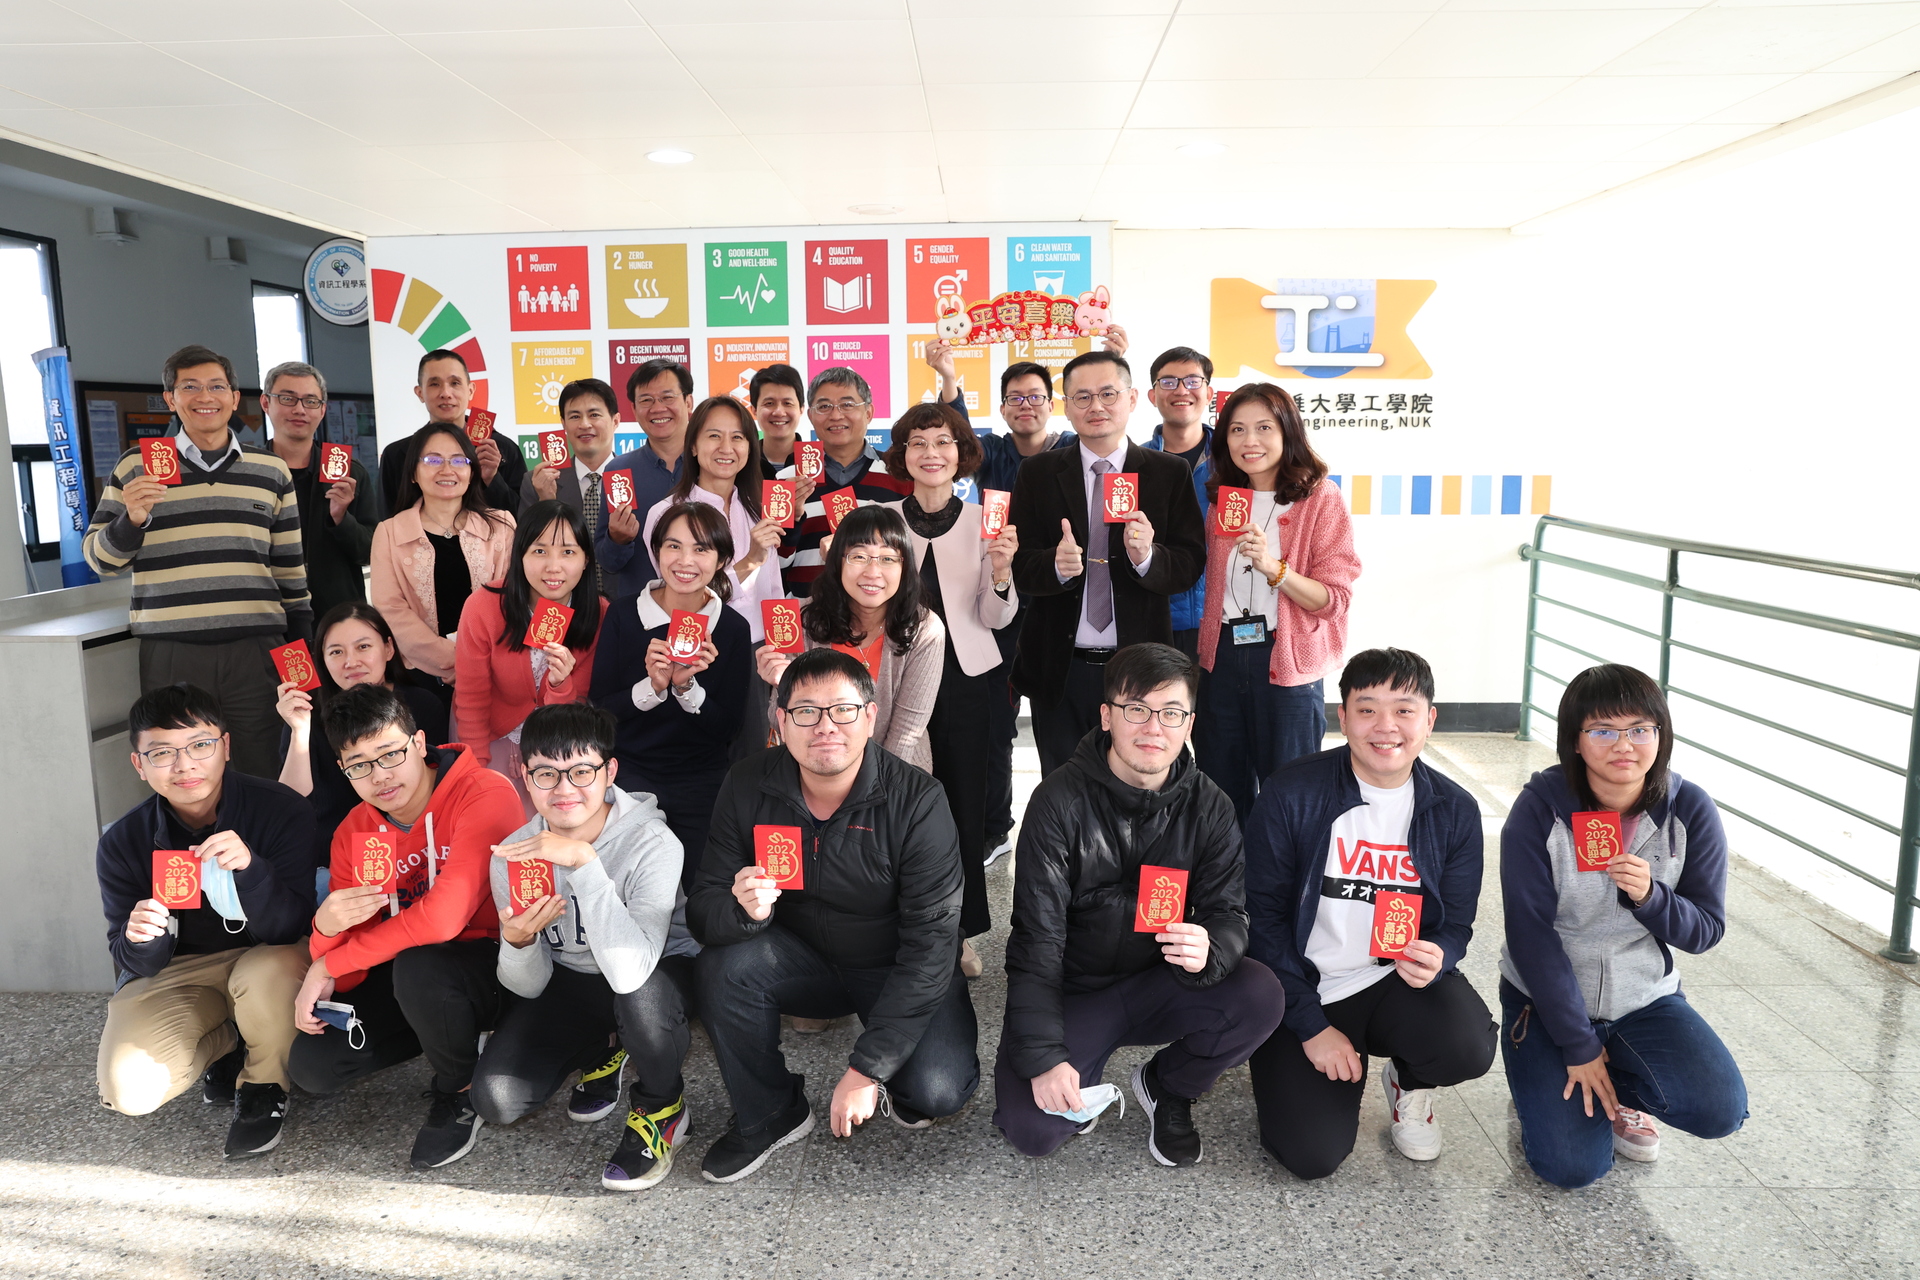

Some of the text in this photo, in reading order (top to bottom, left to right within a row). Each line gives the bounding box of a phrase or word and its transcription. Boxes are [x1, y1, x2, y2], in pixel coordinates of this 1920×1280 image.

[829, 247, 854, 256] QUALITY
[930, 245, 954, 254] GENDER
[1031, 243, 1072, 252] CLEAN WATER
[628, 251, 644, 260] ZERO
[728, 248, 768, 257] GOOD HEALTH
[812, 247, 822, 265] 4
[913, 245, 923, 264] 5
[1014, 243, 1025, 262] 6
[529, 254, 538, 262] NO
[613, 251, 622, 270] 2
[712, 249, 722, 268] 3
[829, 256, 863, 265] EDUCATION
[930, 255, 959, 264] EQUALITY
[1031, 253, 1080, 262] AND SANITATION
[515, 254, 523, 273] 1
[530, 263, 557, 272] POVERTY
[629, 261, 653, 270] HUNGER
[729, 258, 777, 268] AND WELL-BEING
[972, 300, 1074, 331] 平安喜樂
[630, 344, 685, 354] DECENT WORK AND
[755, 343, 787, 352] INNOVATION
[833, 342, 861, 350] REDUCED
[1013, 340, 1029, 357] 12
[534, 347, 584, 356] AFFORDABLE AND
[616, 346, 626, 364] 8
[714, 344, 724, 362] 9
[812, 342, 829, 360] 10
[833, 351, 873, 360] INEQUALITIES
[951, 349, 983, 358] MMUNITIES
[1034, 348, 1076, 357] CONSUMPTION
[519, 348, 527, 366] 7
[534, 357, 576, 366] CLEAN ENERGY
[726, 352, 787, 362] AND INFRASTRUCTURE
[1304, 416, 1431, 430] ngineering, NUK
[523, 440, 539, 459] 13
[1337, 837, 1420, 882] VANS
